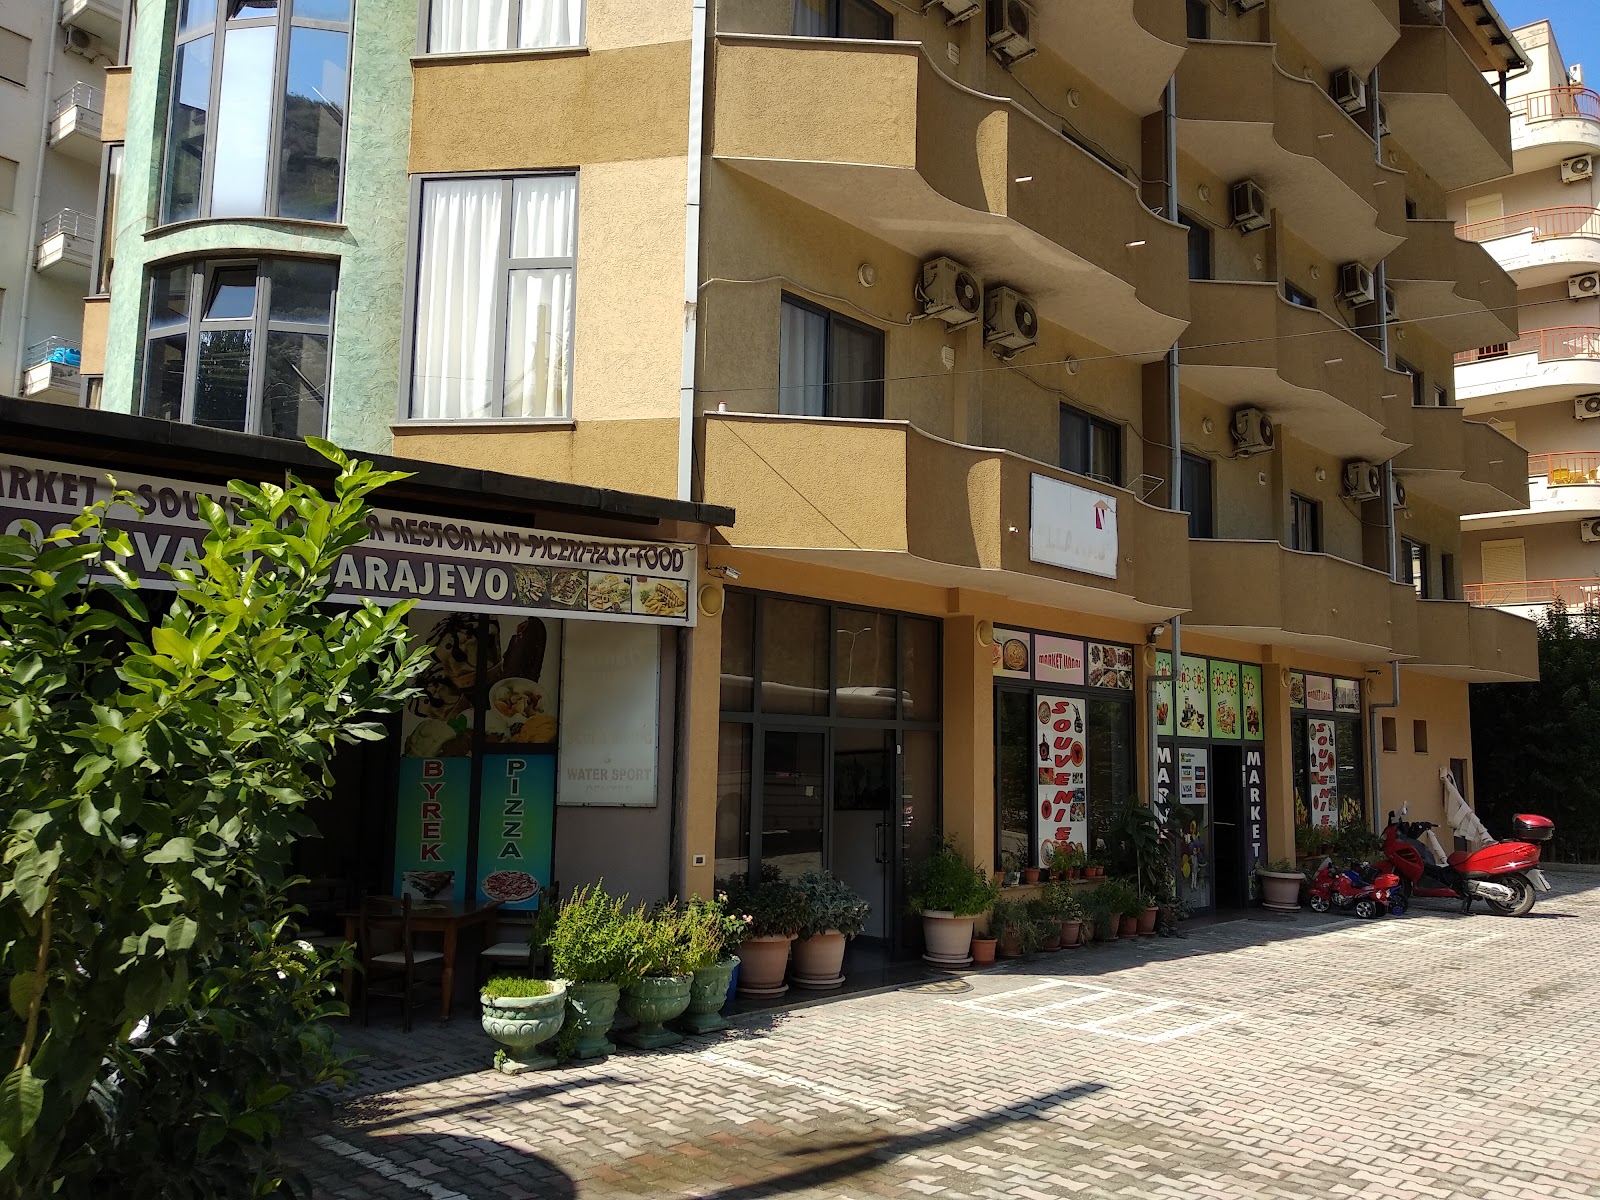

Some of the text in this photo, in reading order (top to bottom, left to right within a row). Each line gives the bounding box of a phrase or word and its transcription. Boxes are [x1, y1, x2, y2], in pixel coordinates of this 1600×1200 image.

[0, 465, 97, 506] RKET
[1038, 653, 1063, 670] MARKET
[497, 758, 527, 860] PIZZA
[567, 768, 652, 781] WATER SPORT
[1246, 751, 1261, 858] MARKET
[420, 759, 446, 862] BYREK
